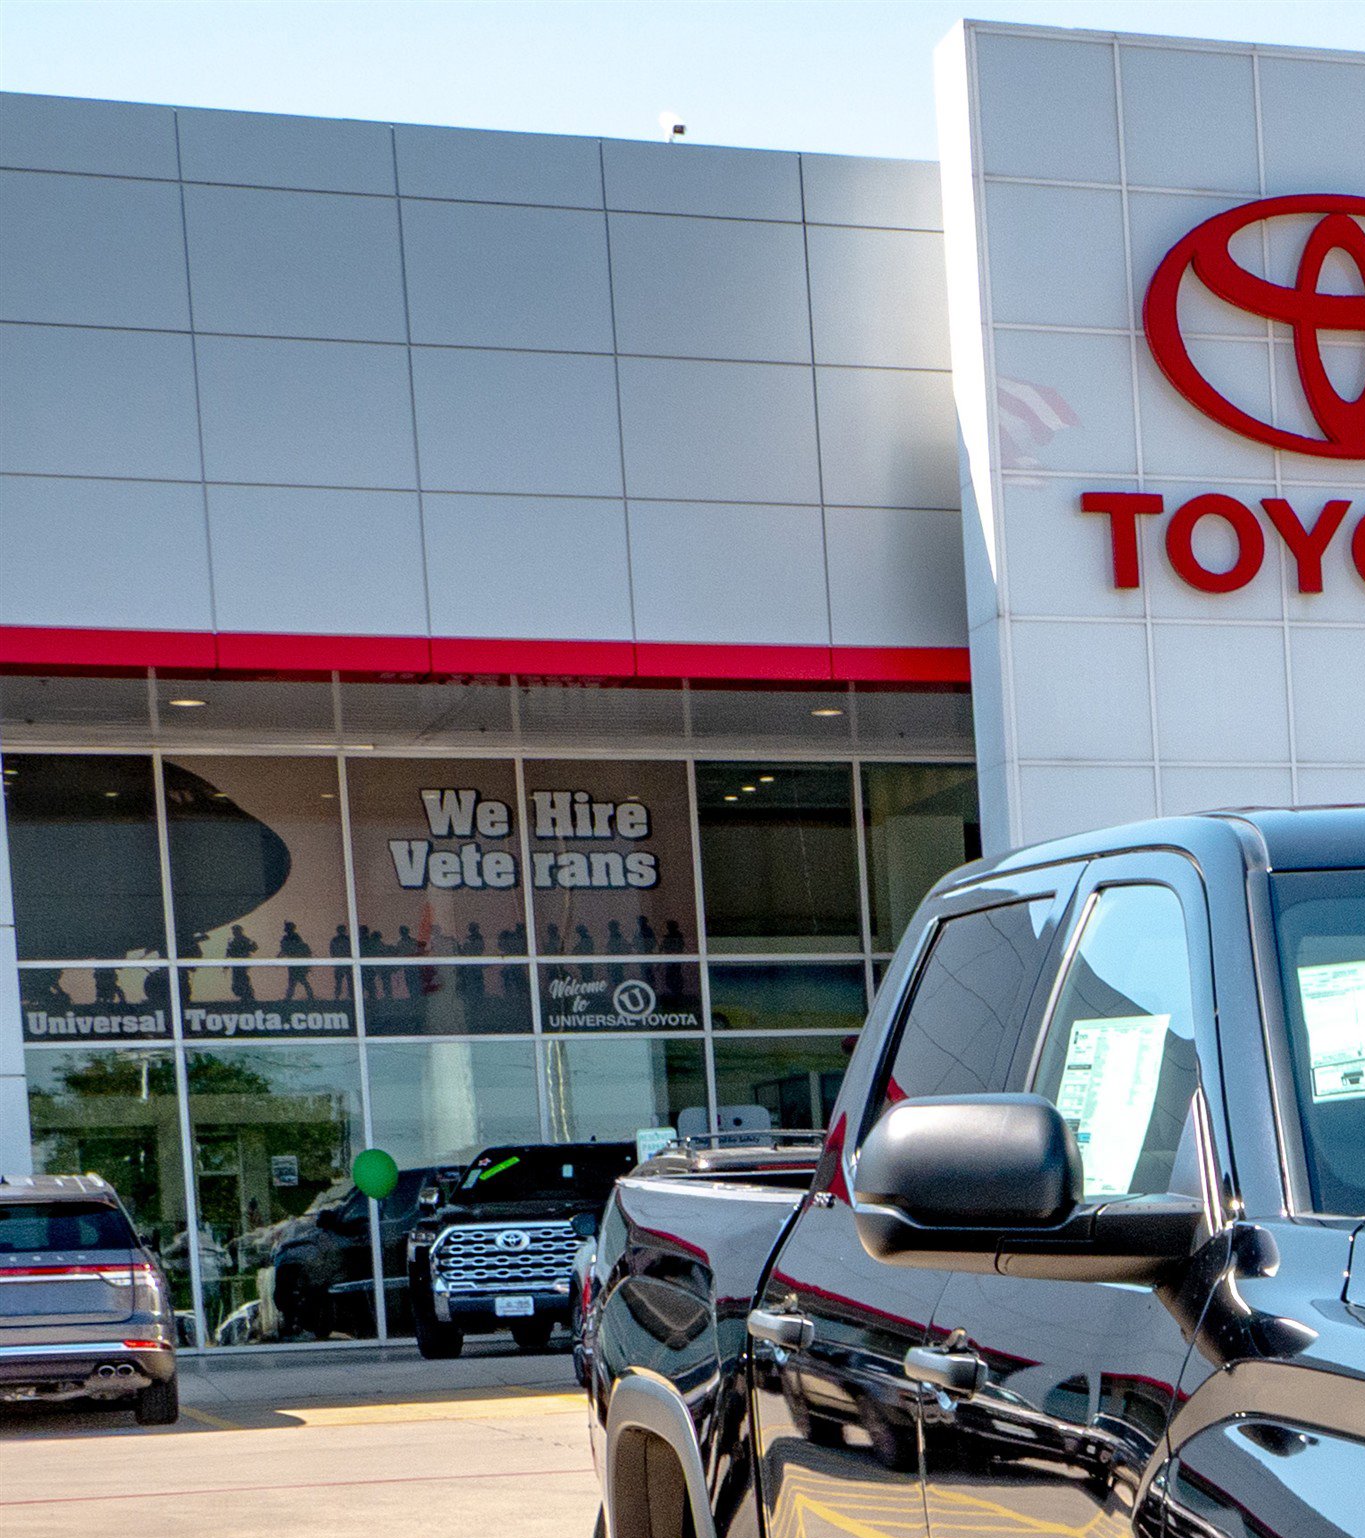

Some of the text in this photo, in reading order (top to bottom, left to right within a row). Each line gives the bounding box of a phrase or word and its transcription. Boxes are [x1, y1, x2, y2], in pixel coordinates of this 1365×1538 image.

[420, 788, 650, 840] We Hire
[549, 975, 608, 999] Welcome
[572, 995, 591, 1013] to
[26, 1009, 349, 1036] Universal Toyota.com
[550, 1013, 698, 1027] UNIVERSAL TOYOTA
